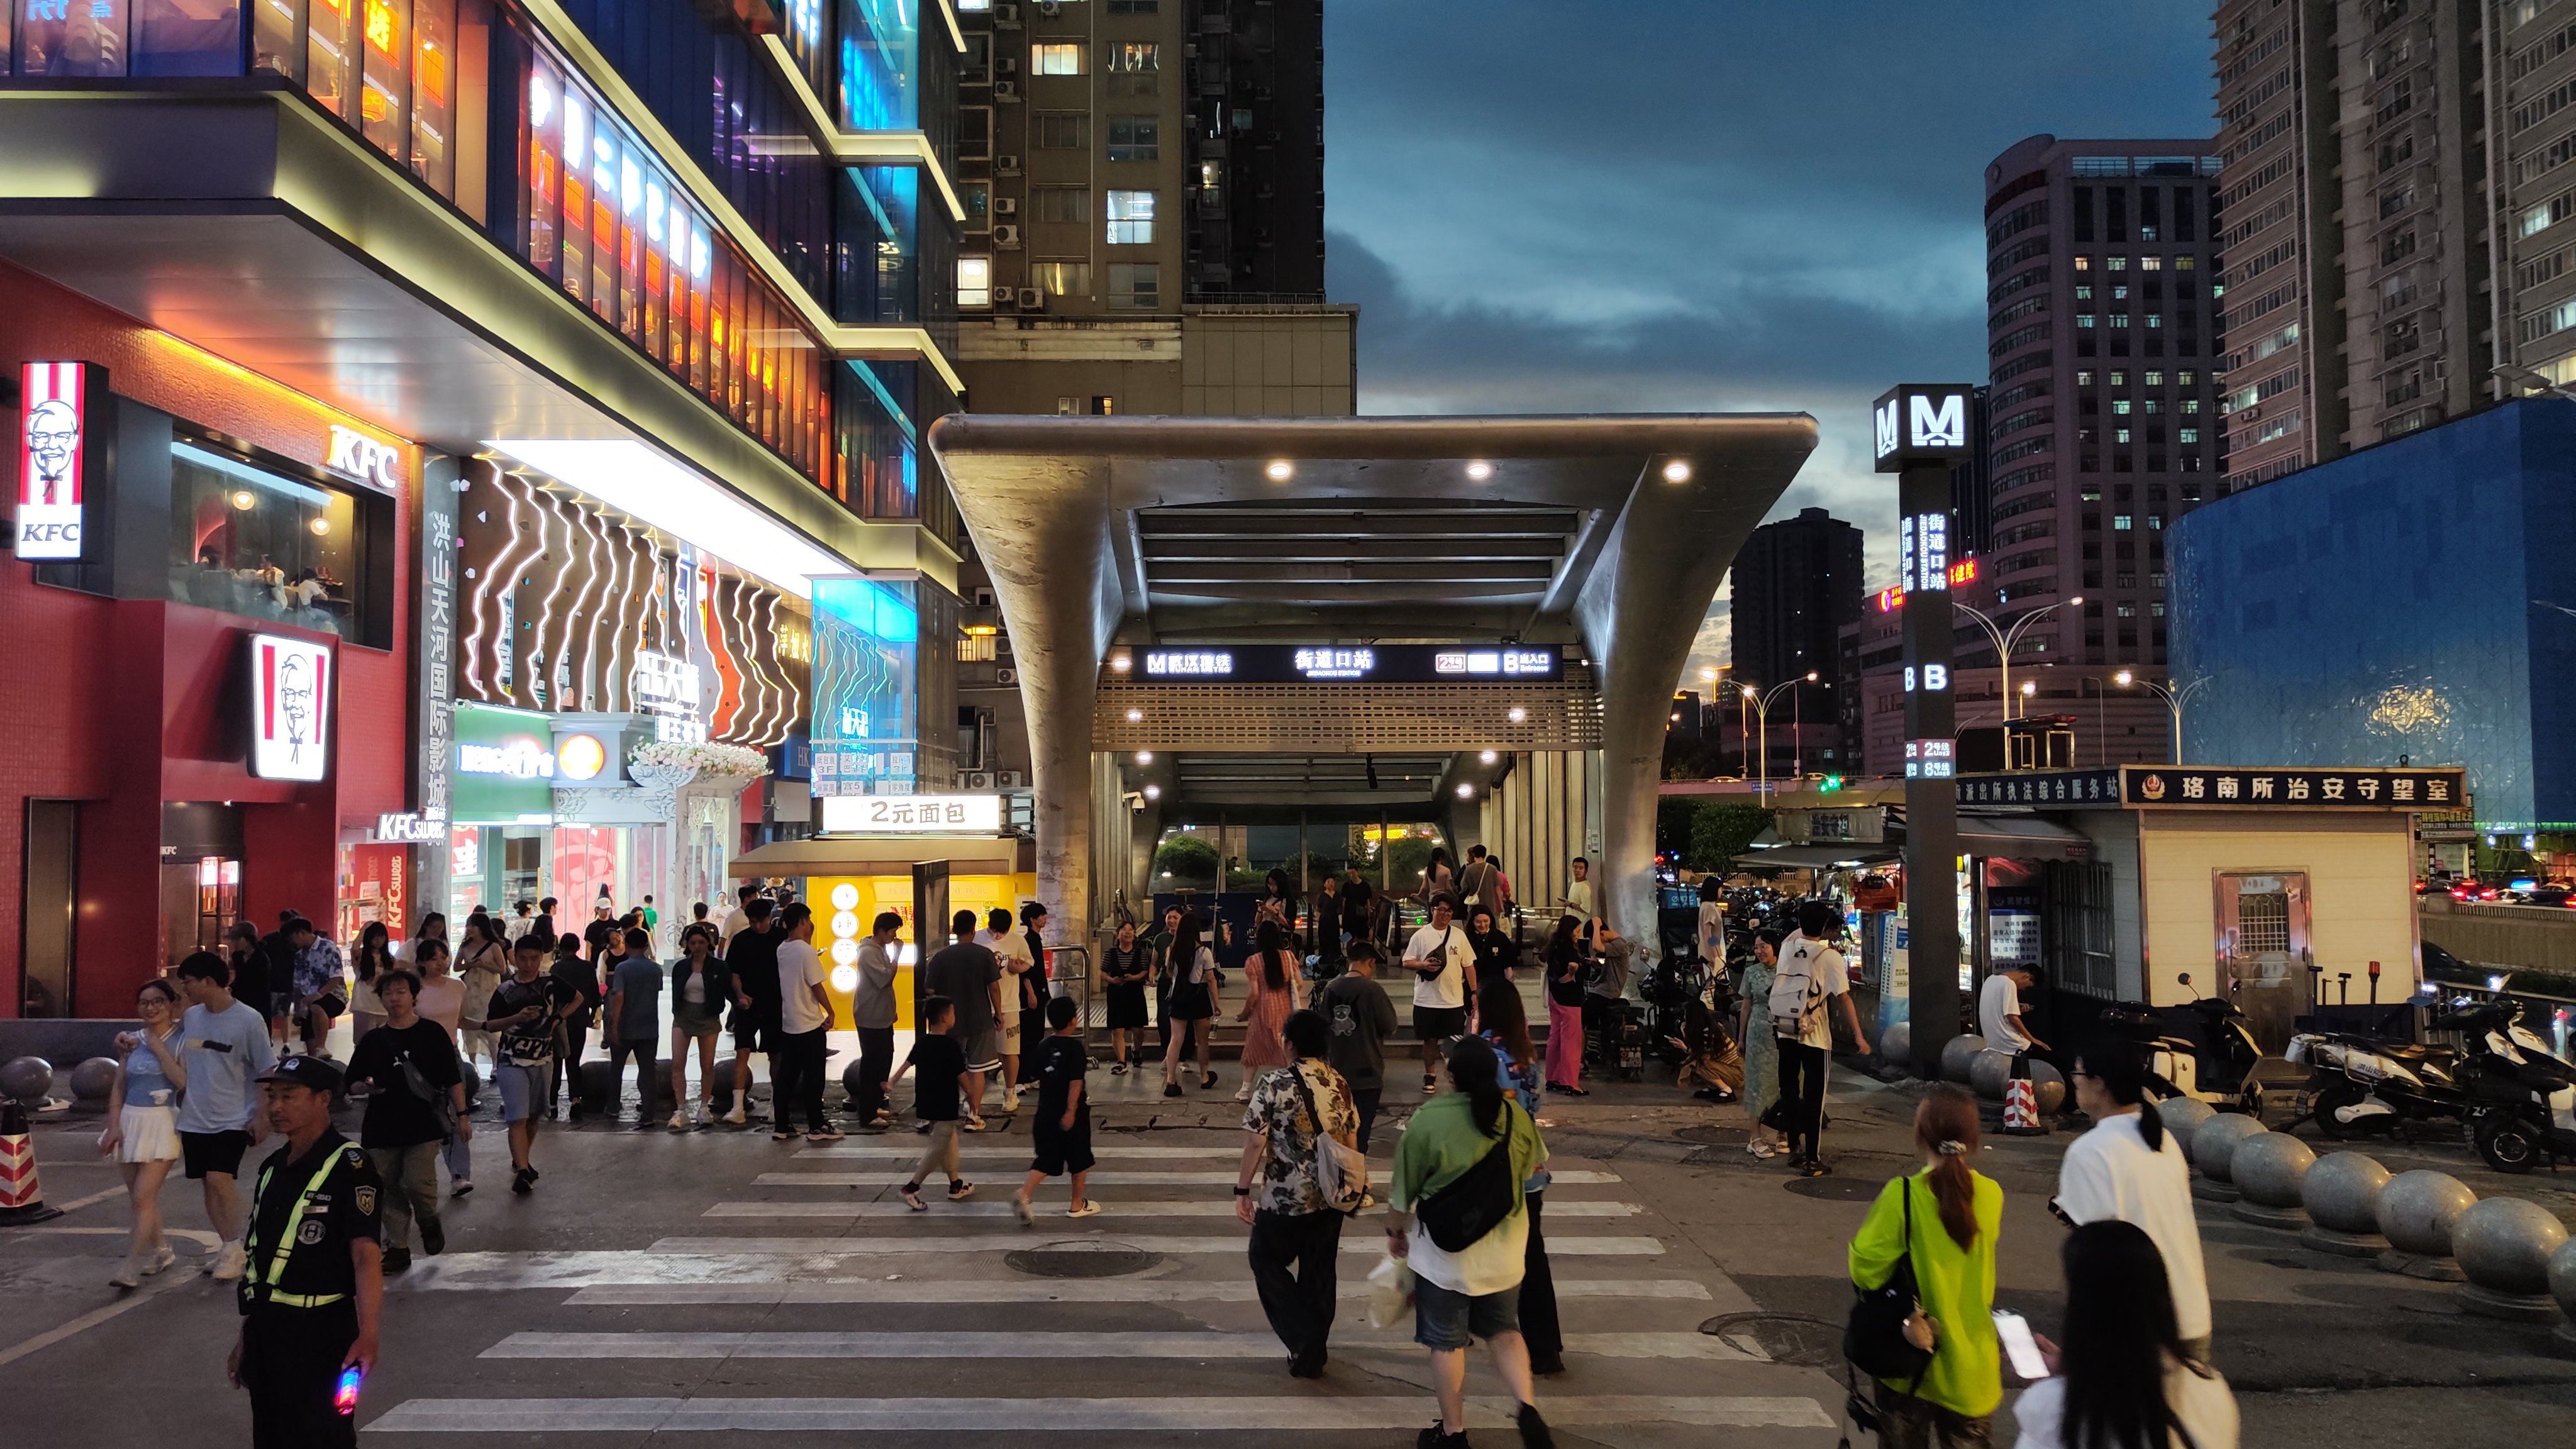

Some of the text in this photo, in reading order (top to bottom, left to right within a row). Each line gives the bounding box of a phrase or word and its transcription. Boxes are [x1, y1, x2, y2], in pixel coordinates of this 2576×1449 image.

[326, 425, 398, 489] KFC
[21, 524, 79, 541] KFC
[1919, 514, 1929, 590] JIEDAOKOU STATION
[1928, 514, 1946, 590] 街道口站
[428, 513, 451, 808] 洪山天河国际影城
[1296, 650, 1372, 669] 街道口站
[1504, 654, 1519, 671] B
[1519, 654, 1548, 664] 出入口
[1905, 667, 1914, 691] B
[1924, 665, 1948, 690] B
[2182, 776, 2449, 801] 珞南所治安守望室
[871, 801, 965, 823] 2元面包
[160, 846, 177, 855] KFC
